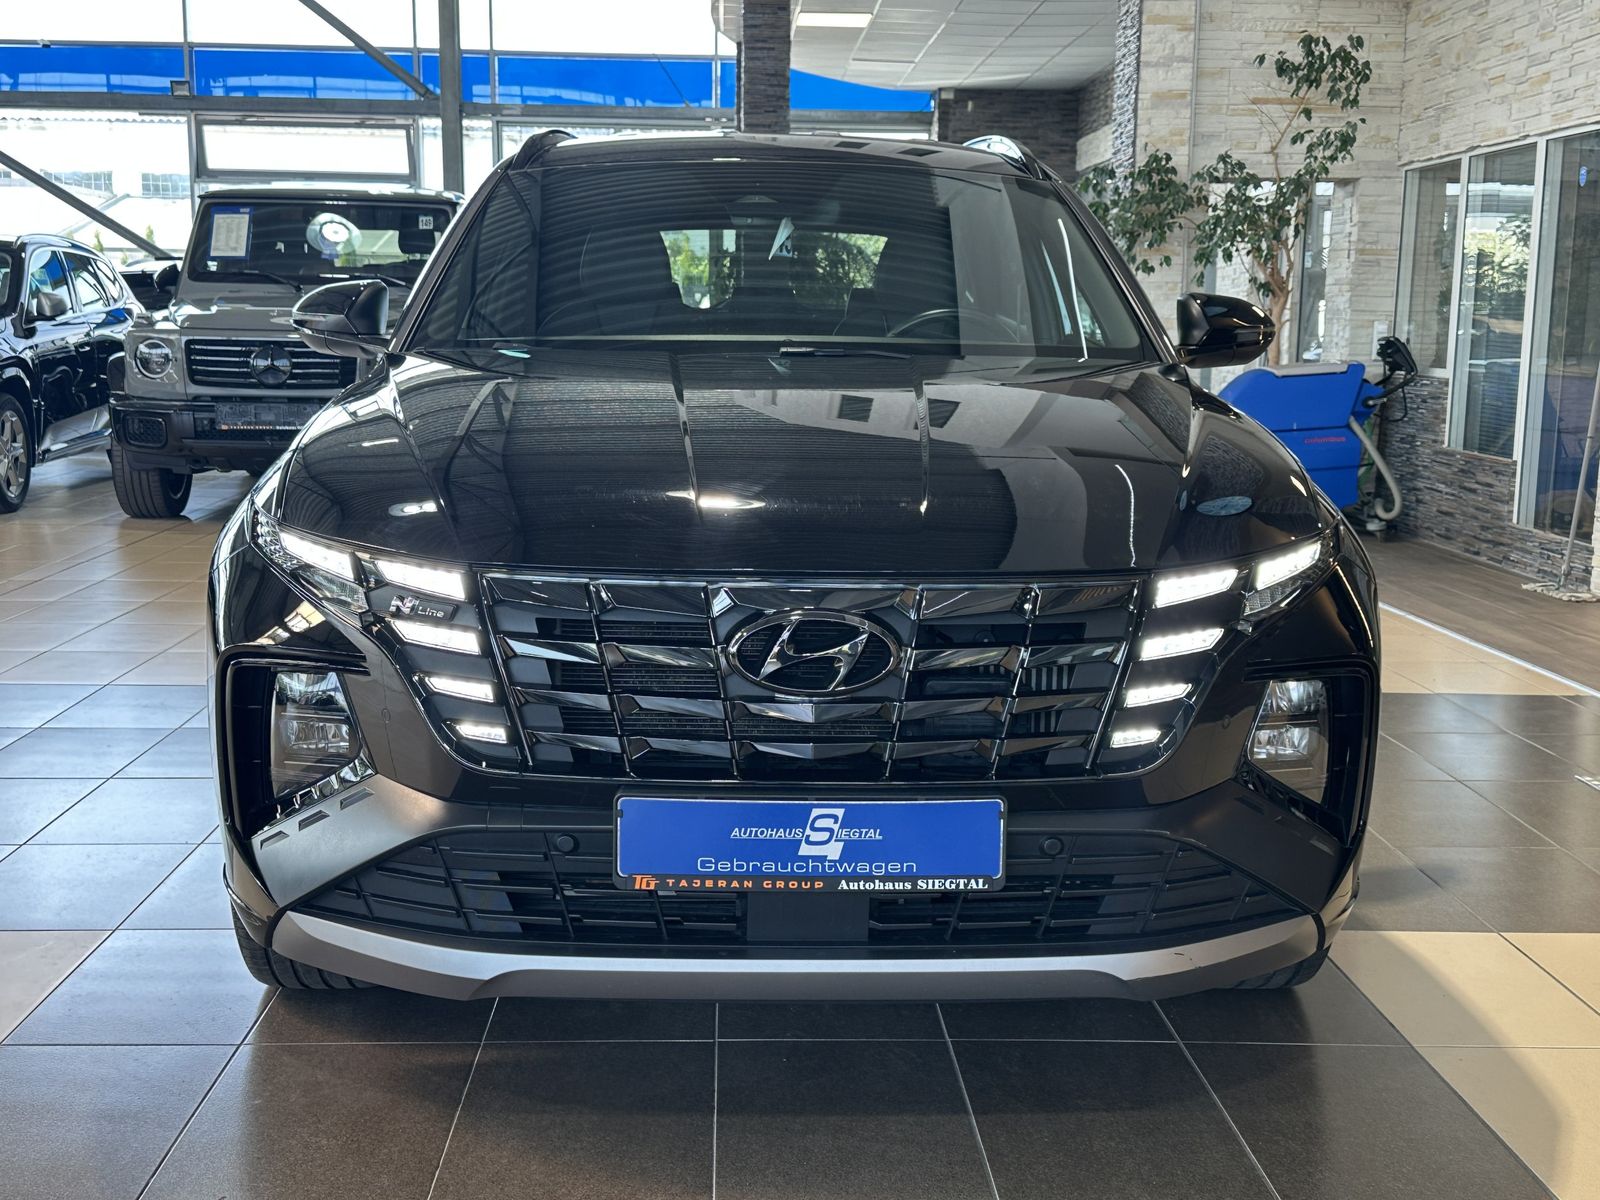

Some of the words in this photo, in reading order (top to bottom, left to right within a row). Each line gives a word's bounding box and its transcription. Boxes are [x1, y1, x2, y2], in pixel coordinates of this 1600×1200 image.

[730, 827, 804, 840] AUTOHAUS
[697, 857, 917, 875] Gebrauchtwagen
[632, 875, 660, 890] TG
[666, 879, 753, 888] TAJERAN
[763, 880, 825, 889] GROUP
[837, 879, 912, 890] Autohaus
[917, 878, 988, 890] SIEGTAL
